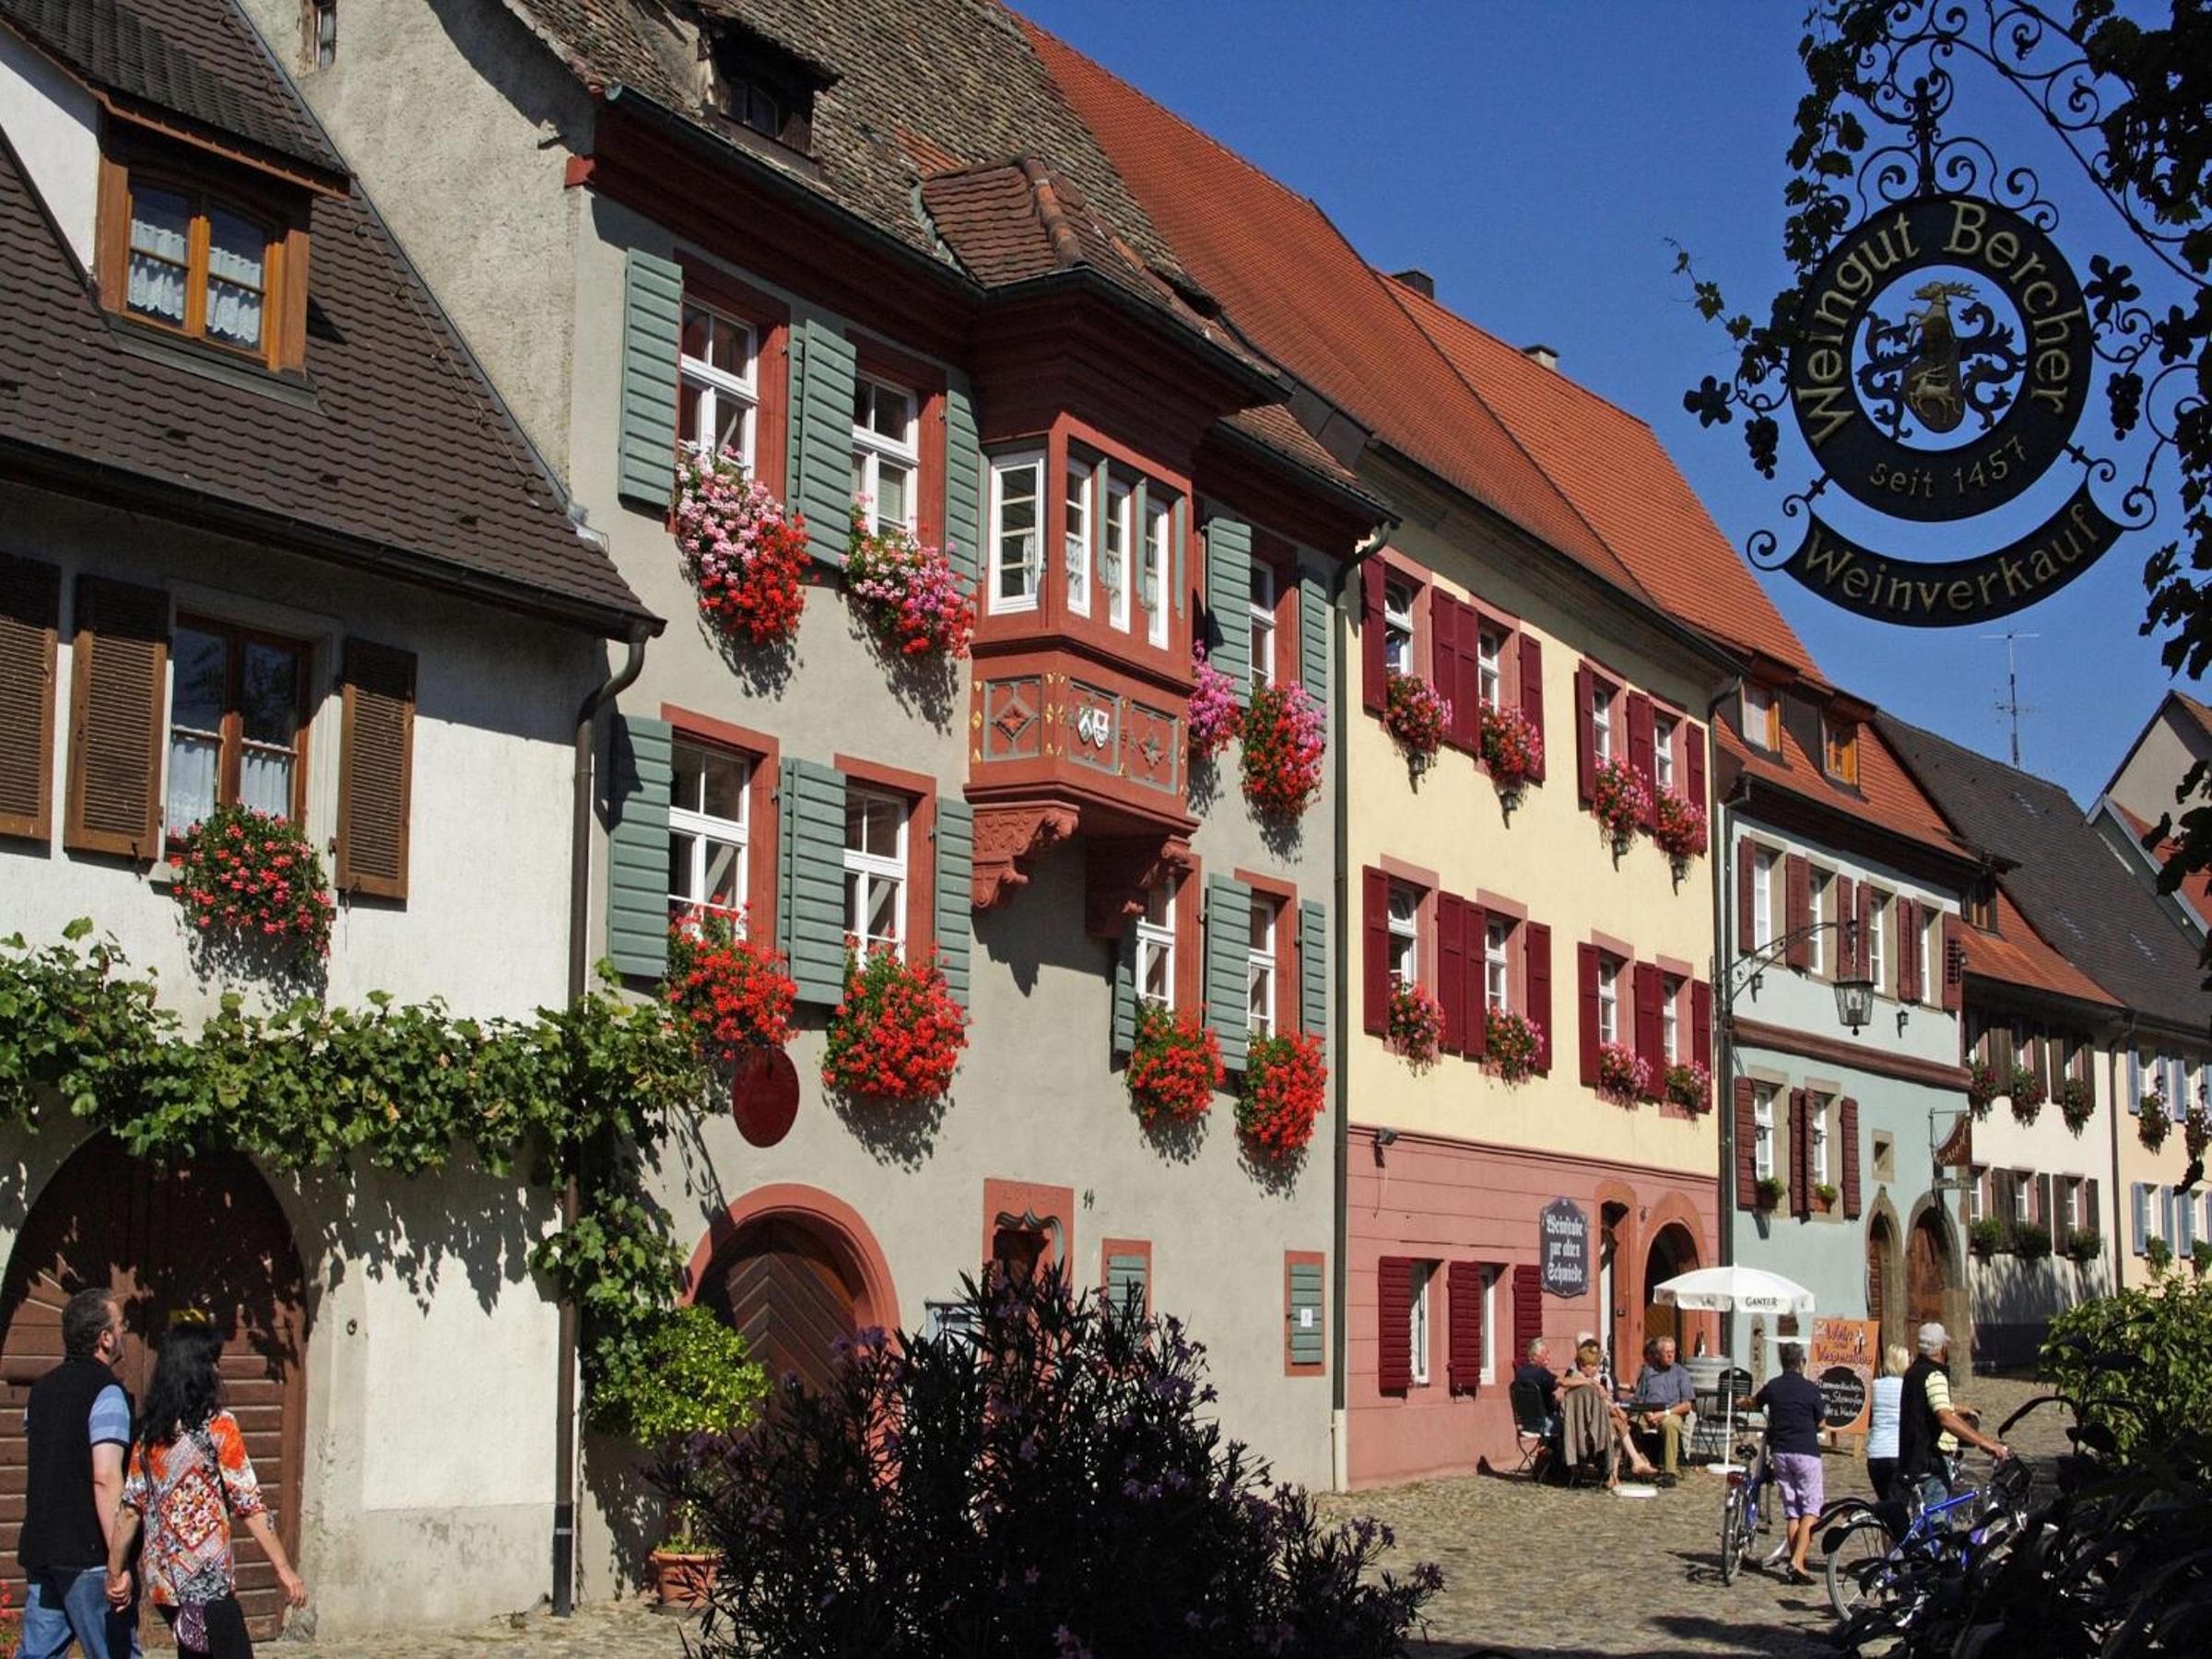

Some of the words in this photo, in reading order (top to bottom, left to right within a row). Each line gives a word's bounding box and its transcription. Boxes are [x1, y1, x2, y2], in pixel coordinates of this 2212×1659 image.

[1796, 211, 1920, 446] Weingut
[1941, 199, 2084, 414] Bercher
[1953, 437, 2027, 494] 1457
[1804, 503, 2100, 612] Weinverkauf
[1546, 1215, 1583, 1237] Weinstube
[1547, 1262, 1583, 1286] Schmiede
[1745, 1296, 1778, 1307] GANTER
